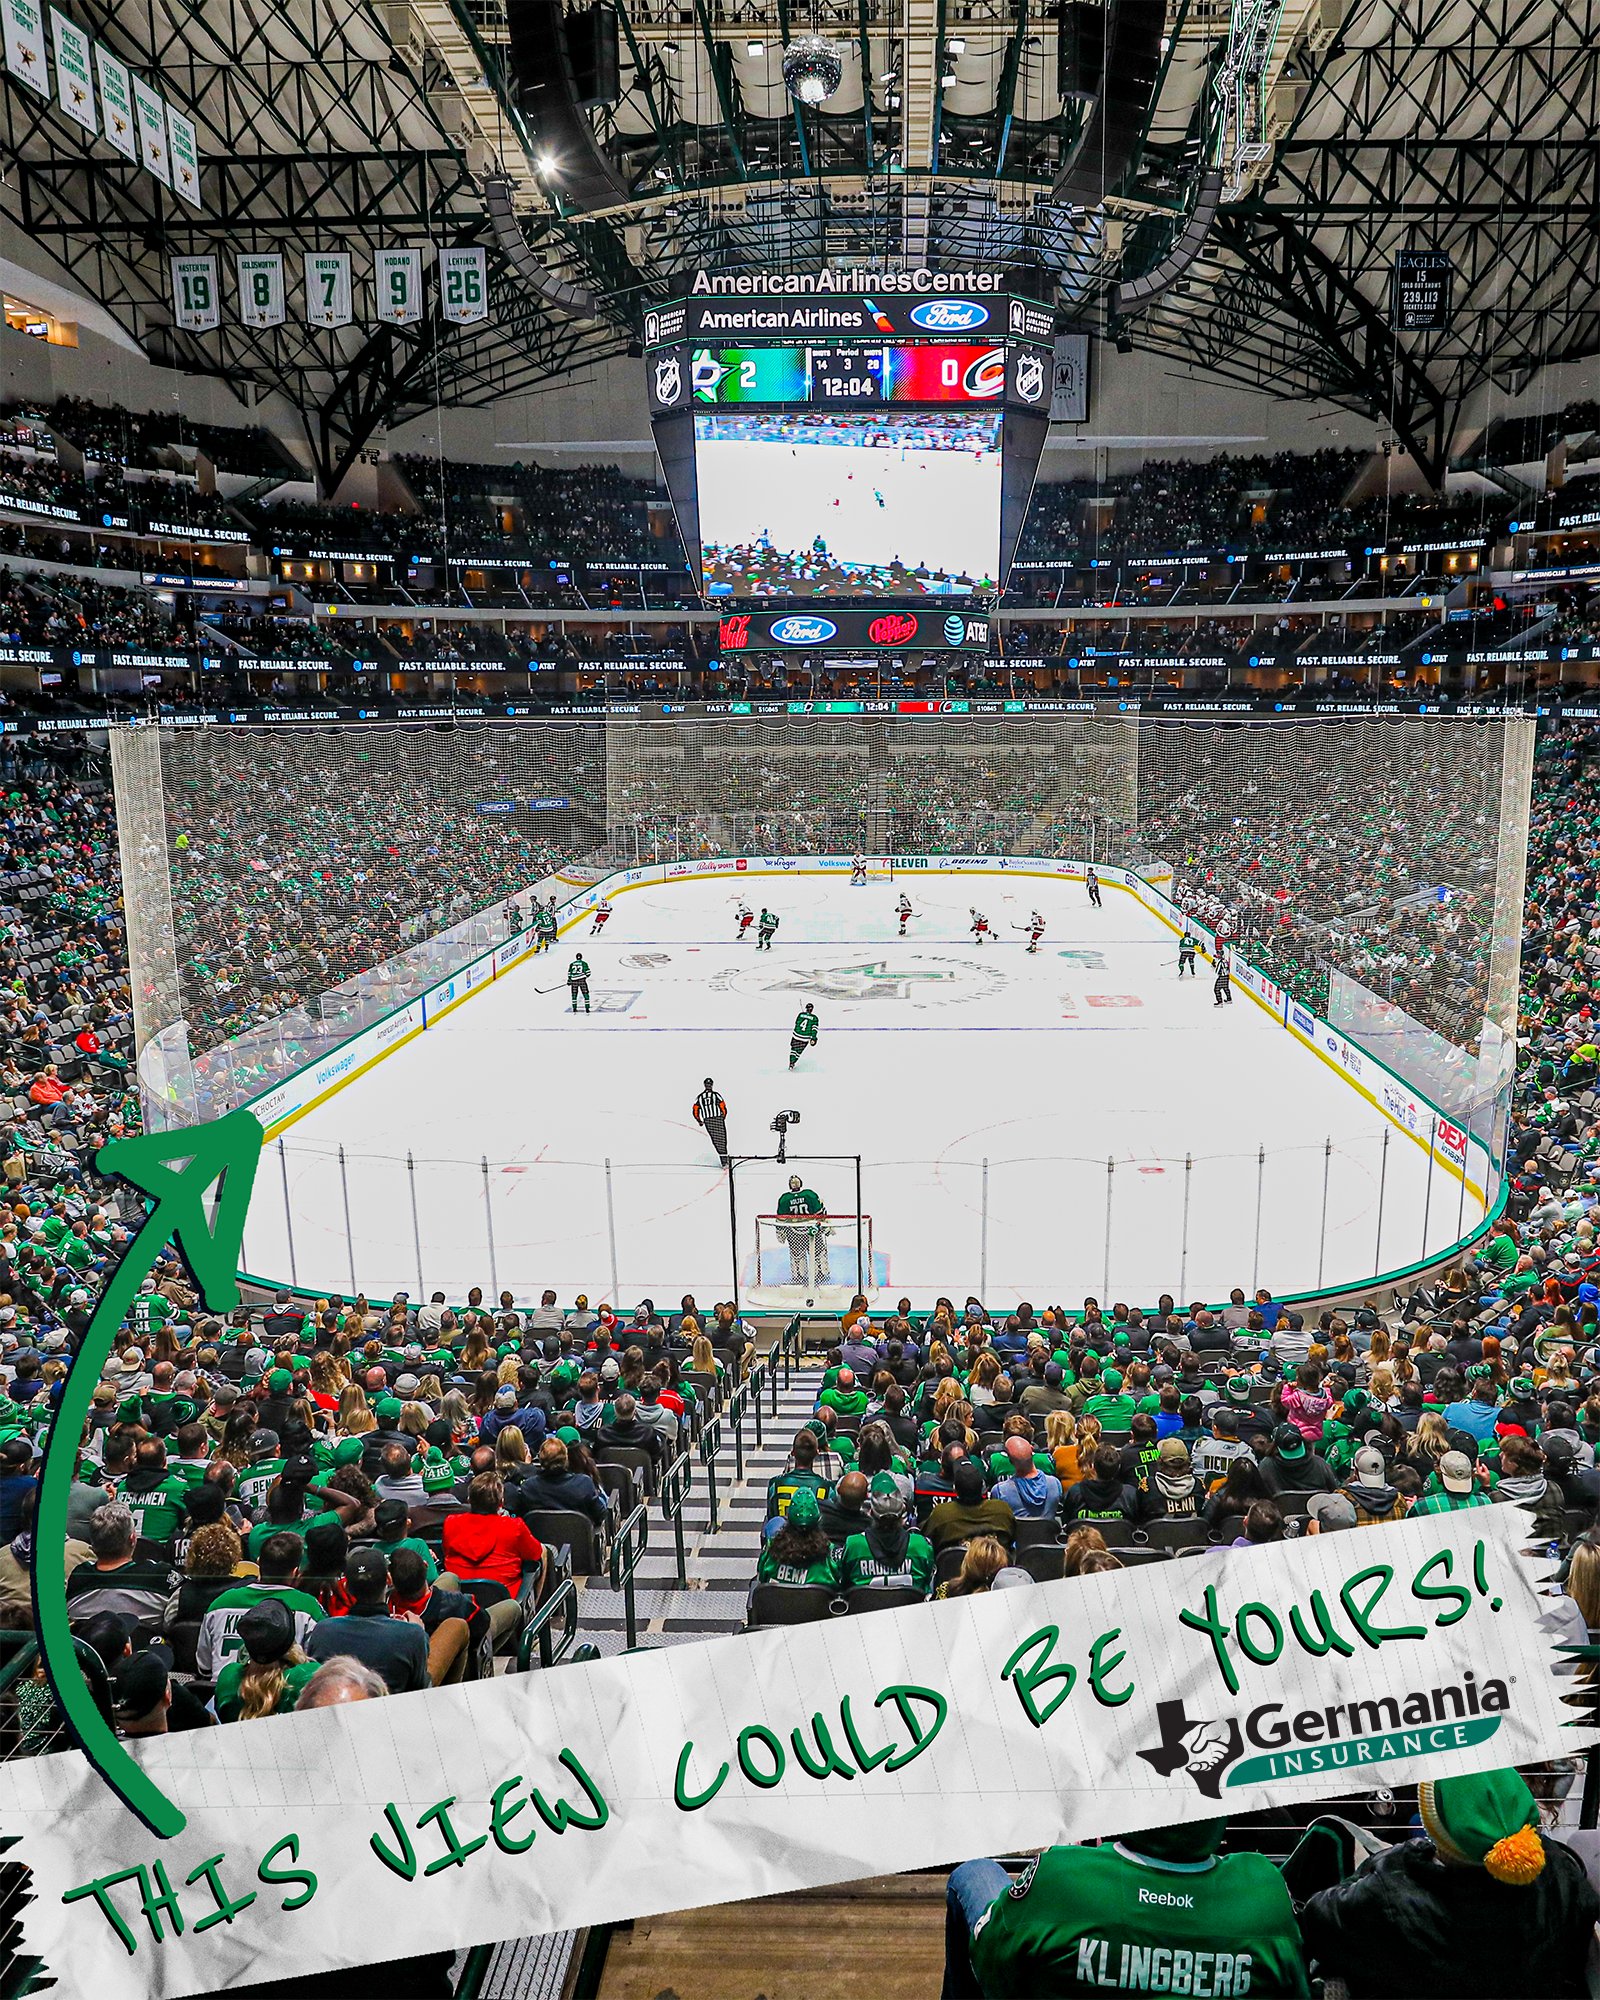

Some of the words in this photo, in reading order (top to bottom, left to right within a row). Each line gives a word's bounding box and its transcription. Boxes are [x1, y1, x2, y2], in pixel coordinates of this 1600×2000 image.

[315, 260, 340, 269] BROTEN
[384, 256, 410, 266] MODANO
[448, 256, 477, 266] LEHTINEN
[1398, 256, 1446, 269] EAGLES
[1416, 270, 1427, 282] 15
[182, 276, 211, 310] 19
[253, 273, 270, 307] 8
[320, 273, 336, 307] 7
[390, 271, 407, 305] 9
[446, 270, 481, 304] 26
[660, 309, 686, 322] AMERICAN
[660, 316, 683, 328] AIRLINES
[1026, 310, 1054, 324] AMERICAN
[1026, 317, 1051, 330] AIRLINES
[836, 348, 859, 357] Period
[816, 359, 828, 370] 14
[844, 359, 852, 370] 3
[739, 361, 757, 388] 2
[941, 359, 958, 386] 0
[822, 378, 874, 396] 12:04
[16, 499, 51, 515] RELIABLE.
[52, 506, 80, 520] SECURE.
[1559, 516, 1581, 526] FAST.
[150, 522, 171, 533] FAST.
[172, 525, 213, 538] RELIABLE.
[214, 530, 250, 541] SECURE.
[329, 552, 365, 560] RELIABLE.
[965, 621, 988, 643] AT&T
[19, 650, 53, 663] SECURE.
[82, 654, 95, 663] AT&T
[1467, 653, 1485, 662] FAST.
[1487, 652, 1523, 661] RELIABLE.
[1524, 651, 1548, 660] SECURE.
[1567, 649, 1578, 658] AT&T
[113, 655, 132, 665] FAST.
[132, 656, 164, 666] RELIABLE.
[165, 657, 190, 667] SECURE.
[209, 660, 221, 668] AT&T
[239, 660, 259, 669] FAST.
[260, 661, 296, 669] RELIABLE.
[297, 661, 332, 669] SECURE.
[399, 662, 424, 670] FAST.
[426, 662, 469, 670] RELIABLE.
[471, 662, 505, 670] SECURE.
[579, 662, 602, 670] FAST.
[1189, 658, 1226, 666] SECURE.
[1297, 657, 1320, 665] FAST.
[1322, 656, 1366, 664] RELIABLE.
[1367, 656, 1400, 664] SECURE.
[825, 703, 832, 711] 2
[865, 702, 889, 711] 12:04
[927, 702, 934, 711] 0
[717, 862, 734, 870] SPORTS
[773, 857, 797, 870] Kroger
[818, 860, 850, 868] Volkswa
[315, 1053, 356, 1086] Volkswagen
[255, 1090, 286, 1117] CHOCTAW
[1437, 1118, 1468, 1157] DEX
[1441, 1142, 1466, 1167] imagin
[1166, 1496, 1196, 1514] BENN
[777, 1564, 808, 1585] BENN
[1139, 1888, 1194, 1909] Reebok
[1076, 1937, 1253, 1998] KLINGBERG
